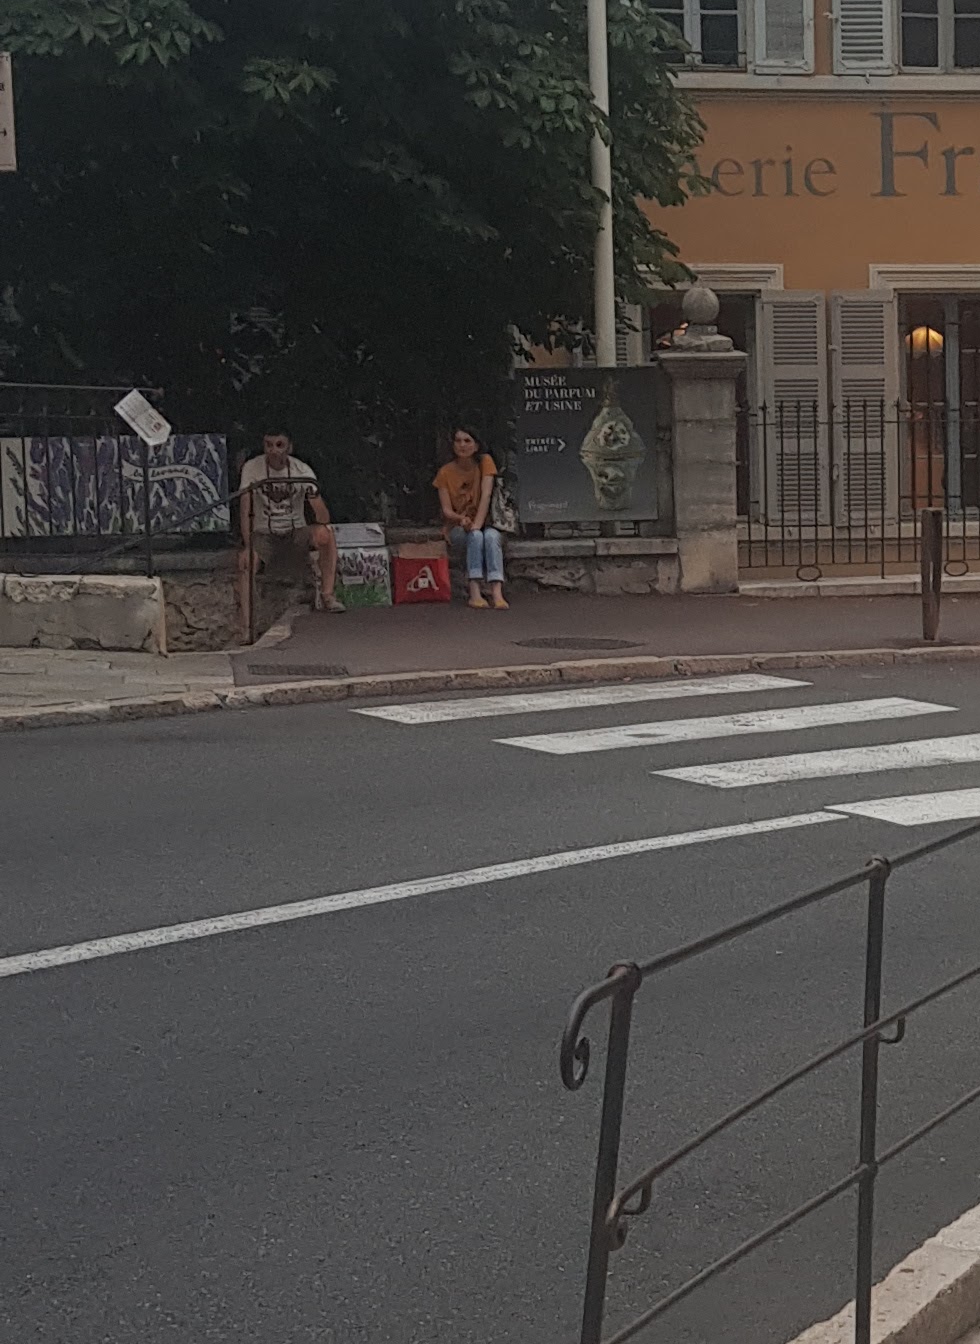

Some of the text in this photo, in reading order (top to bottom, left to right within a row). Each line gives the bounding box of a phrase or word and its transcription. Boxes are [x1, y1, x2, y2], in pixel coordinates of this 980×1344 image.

[690, 144, 838, 198] erie
[524, 374, 567, 386] MUSÉE
[524, 387, 596, 399] DU PARFUM
[525, 400, 582, 411] ET USINE
